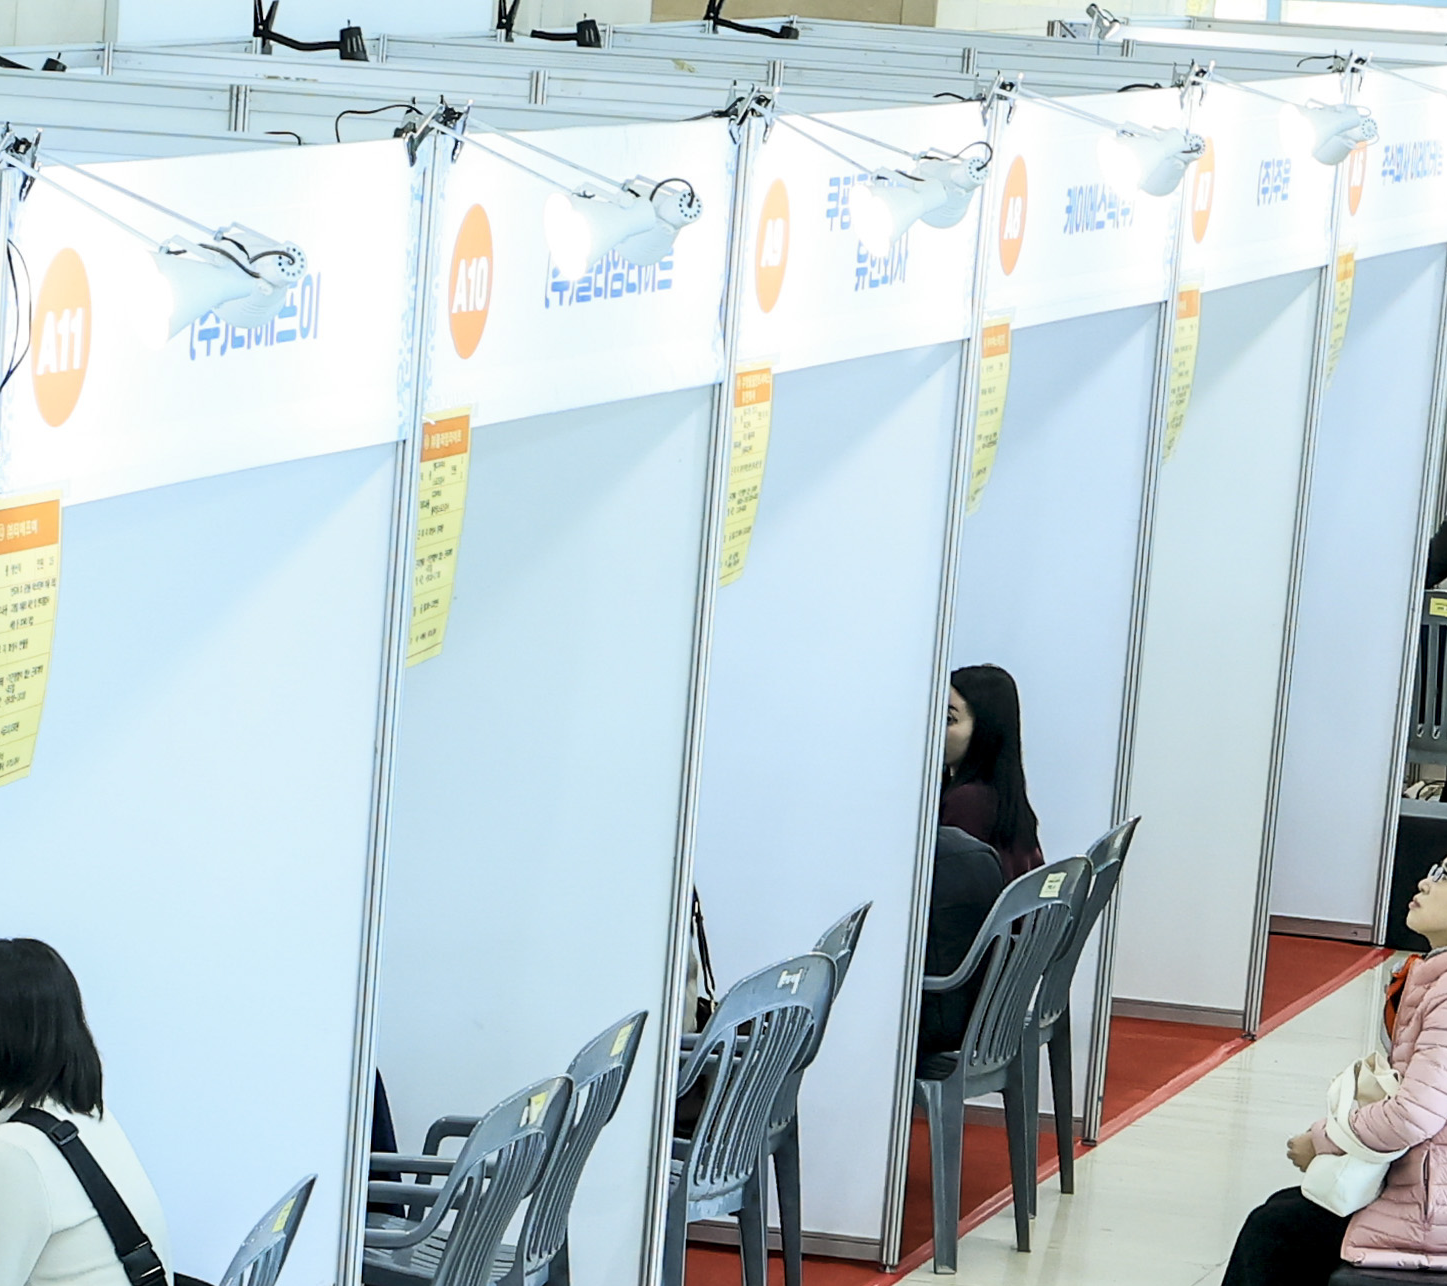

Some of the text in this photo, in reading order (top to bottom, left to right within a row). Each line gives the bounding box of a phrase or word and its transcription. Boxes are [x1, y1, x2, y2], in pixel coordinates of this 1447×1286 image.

[760, 217, 784, 268] A9
[453, 254, 490, 314] A10
[36, 306, 85, 376] A11
